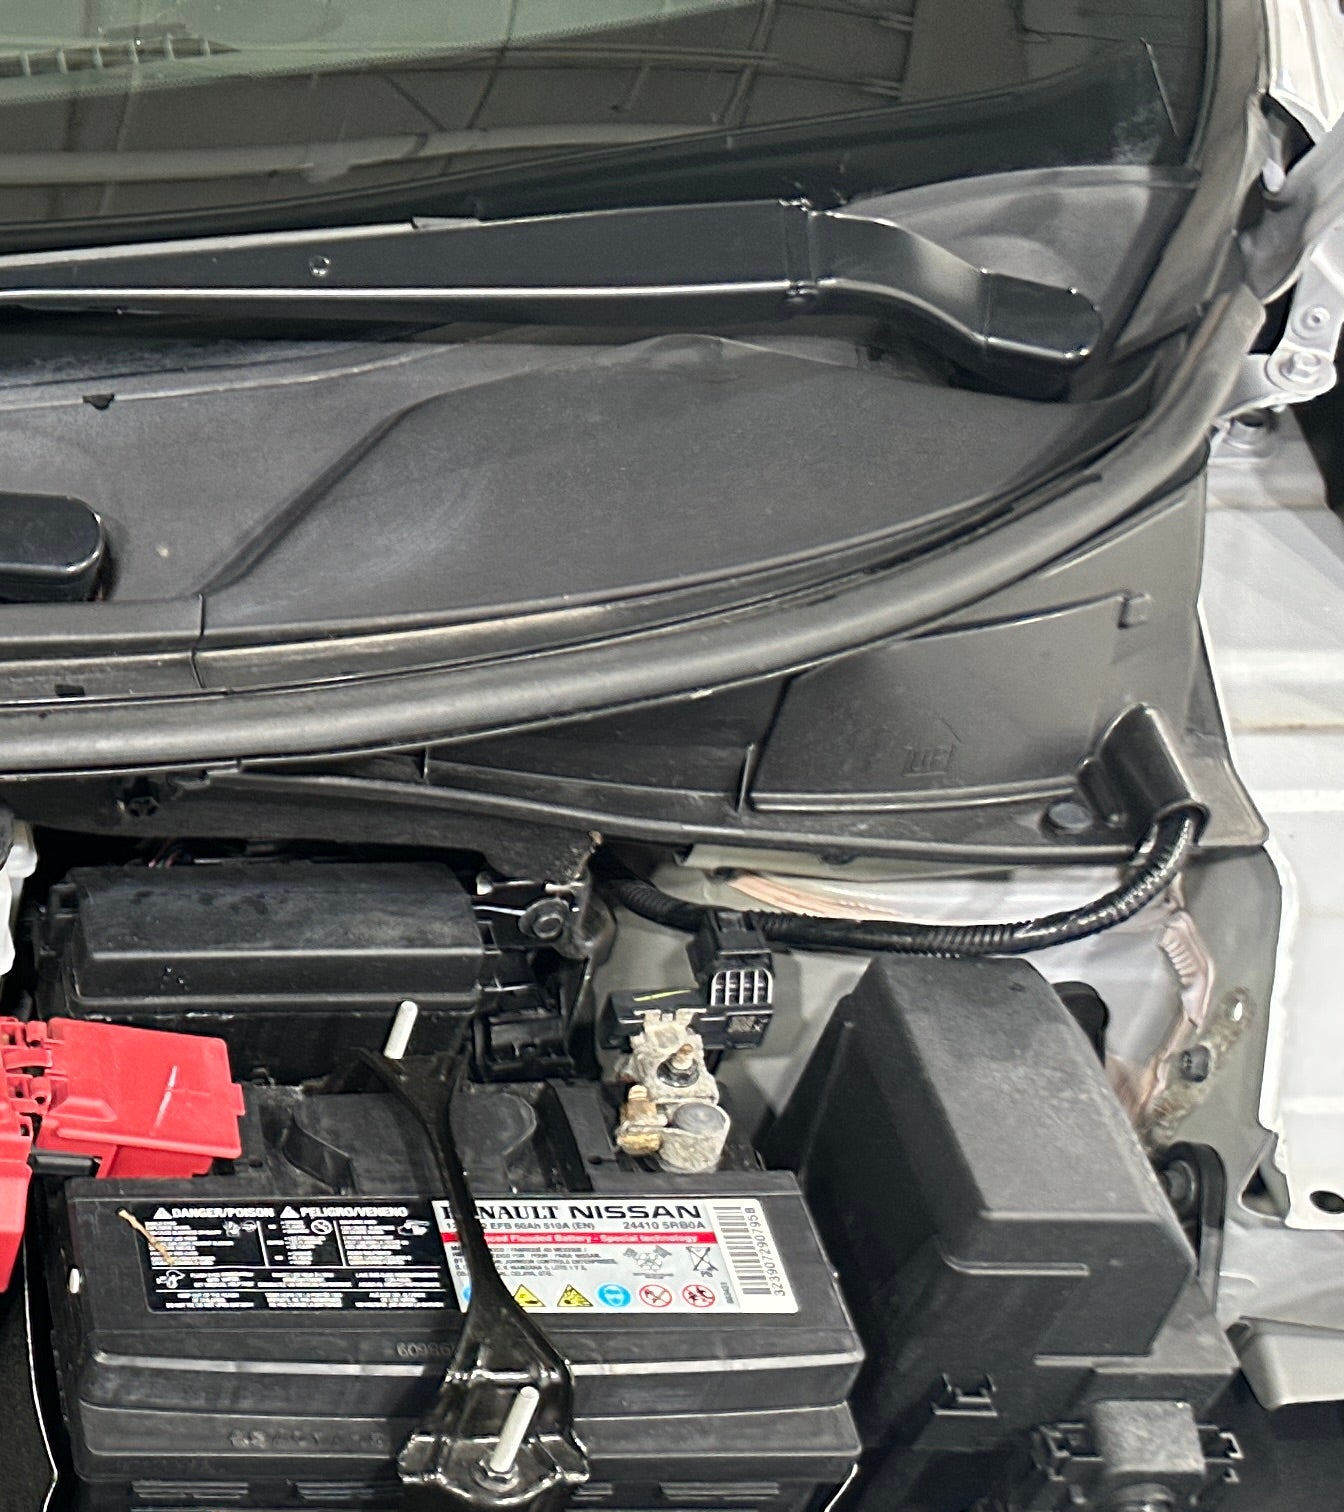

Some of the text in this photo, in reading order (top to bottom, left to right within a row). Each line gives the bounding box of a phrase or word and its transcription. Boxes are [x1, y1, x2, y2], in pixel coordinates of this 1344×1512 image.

[171, 1207, 275, 1218] DANGER/POISON
[299, 1206, 409, 1218] PELIGRO/VENENO
[568, 1205, 702, 1220] NISSAN
[623, 1221, 659, 1230] 24410
